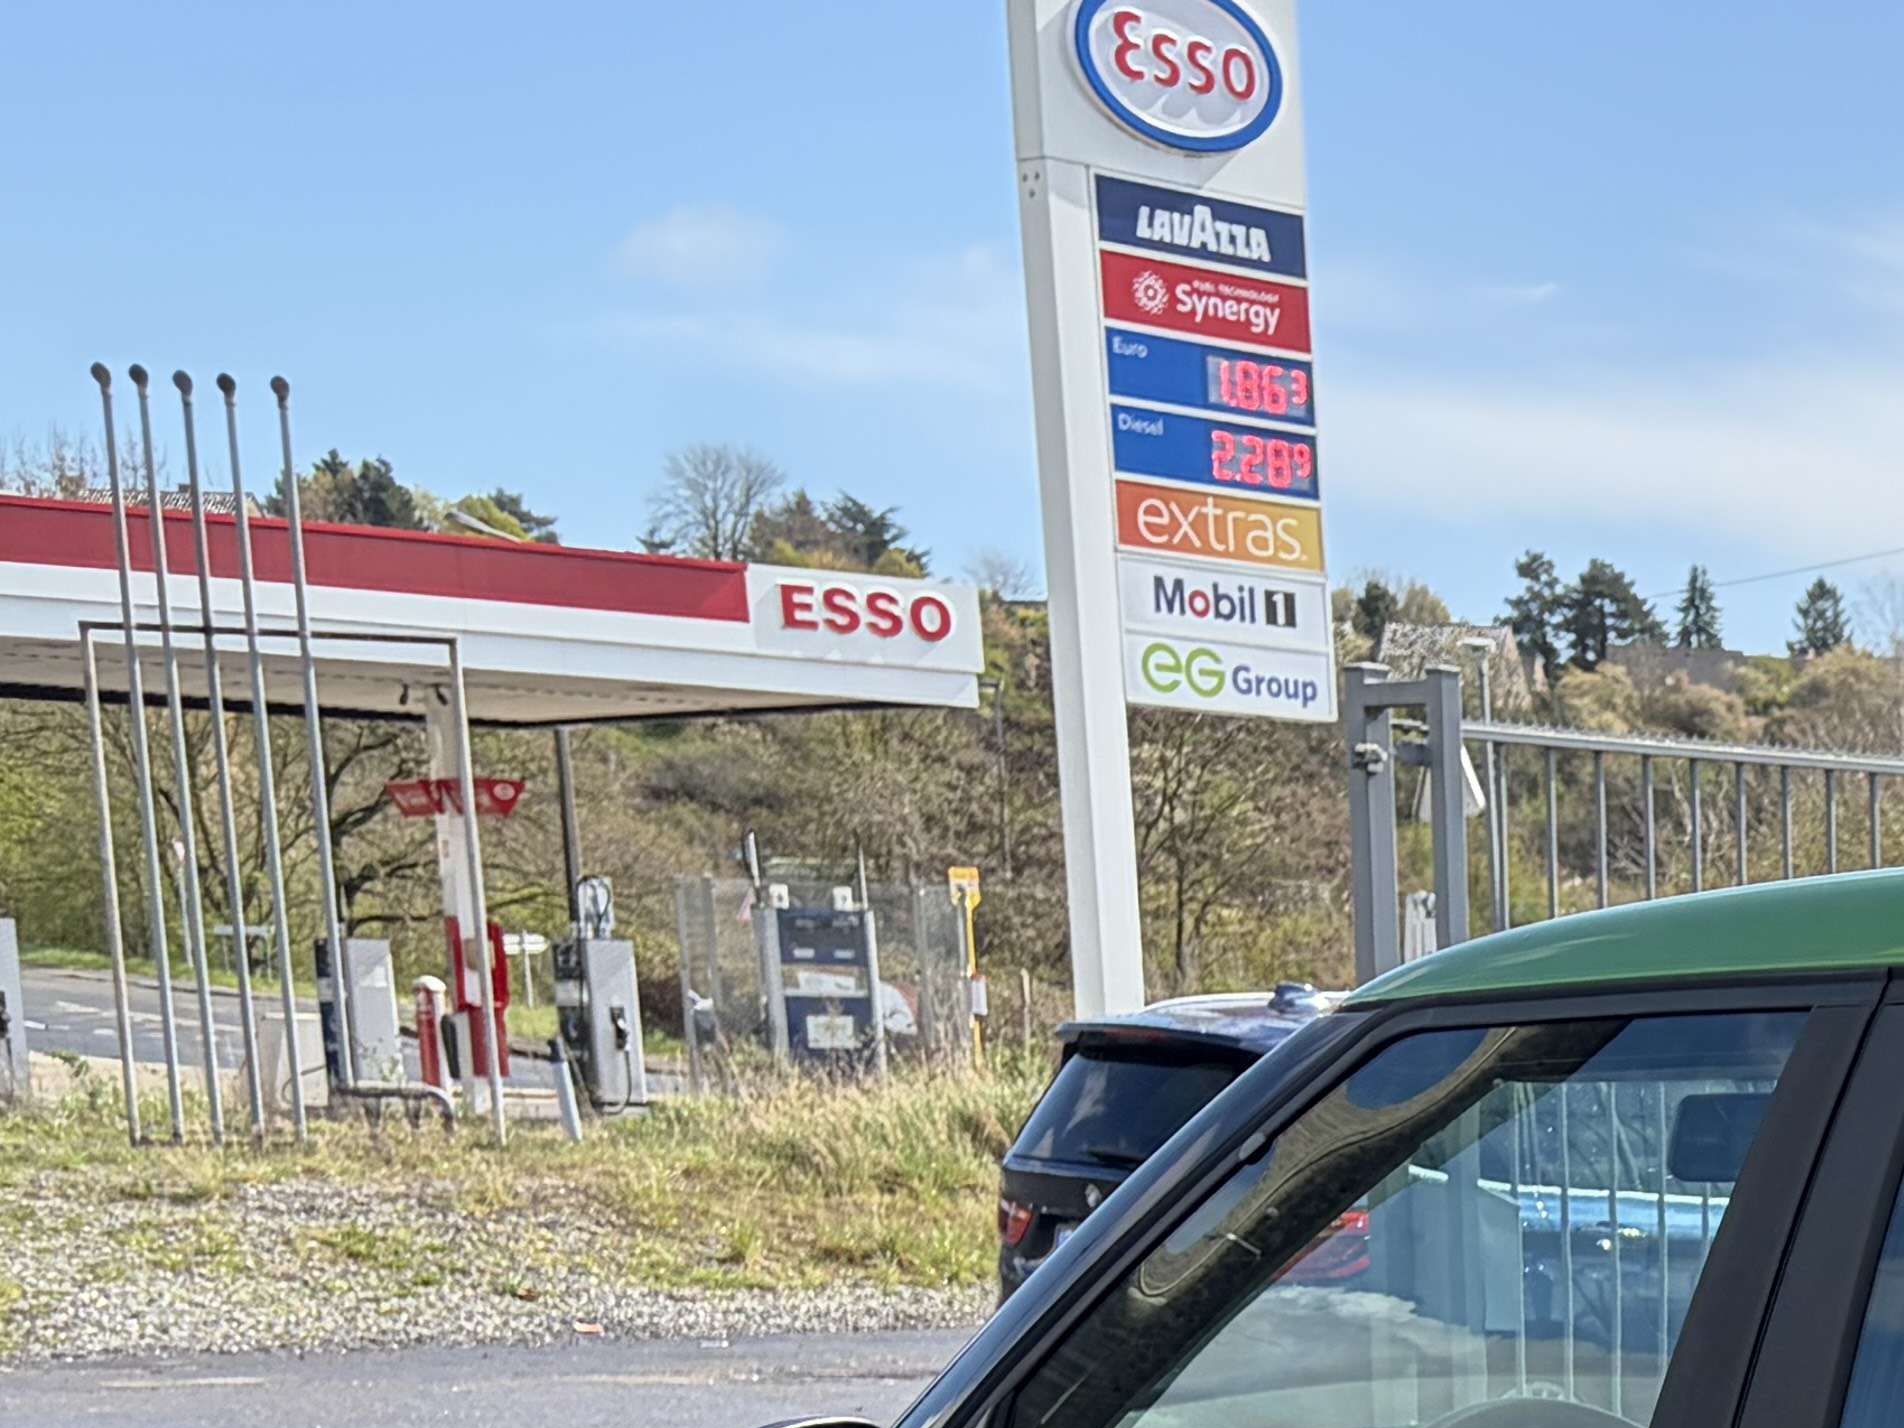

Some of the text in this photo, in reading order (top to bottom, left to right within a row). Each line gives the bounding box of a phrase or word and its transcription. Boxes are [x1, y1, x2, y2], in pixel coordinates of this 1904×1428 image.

[1136, 204, 1271, 262] LAVAZZA
[1175, 283, 1280, 336] Synergy
[1117, 412, 1164, 436] Diesel
[780, 584, 952, 642] ESSO
[1153, 575, 1291, 627] Mobil 1
[1232, 665, 1318, 708] Group
